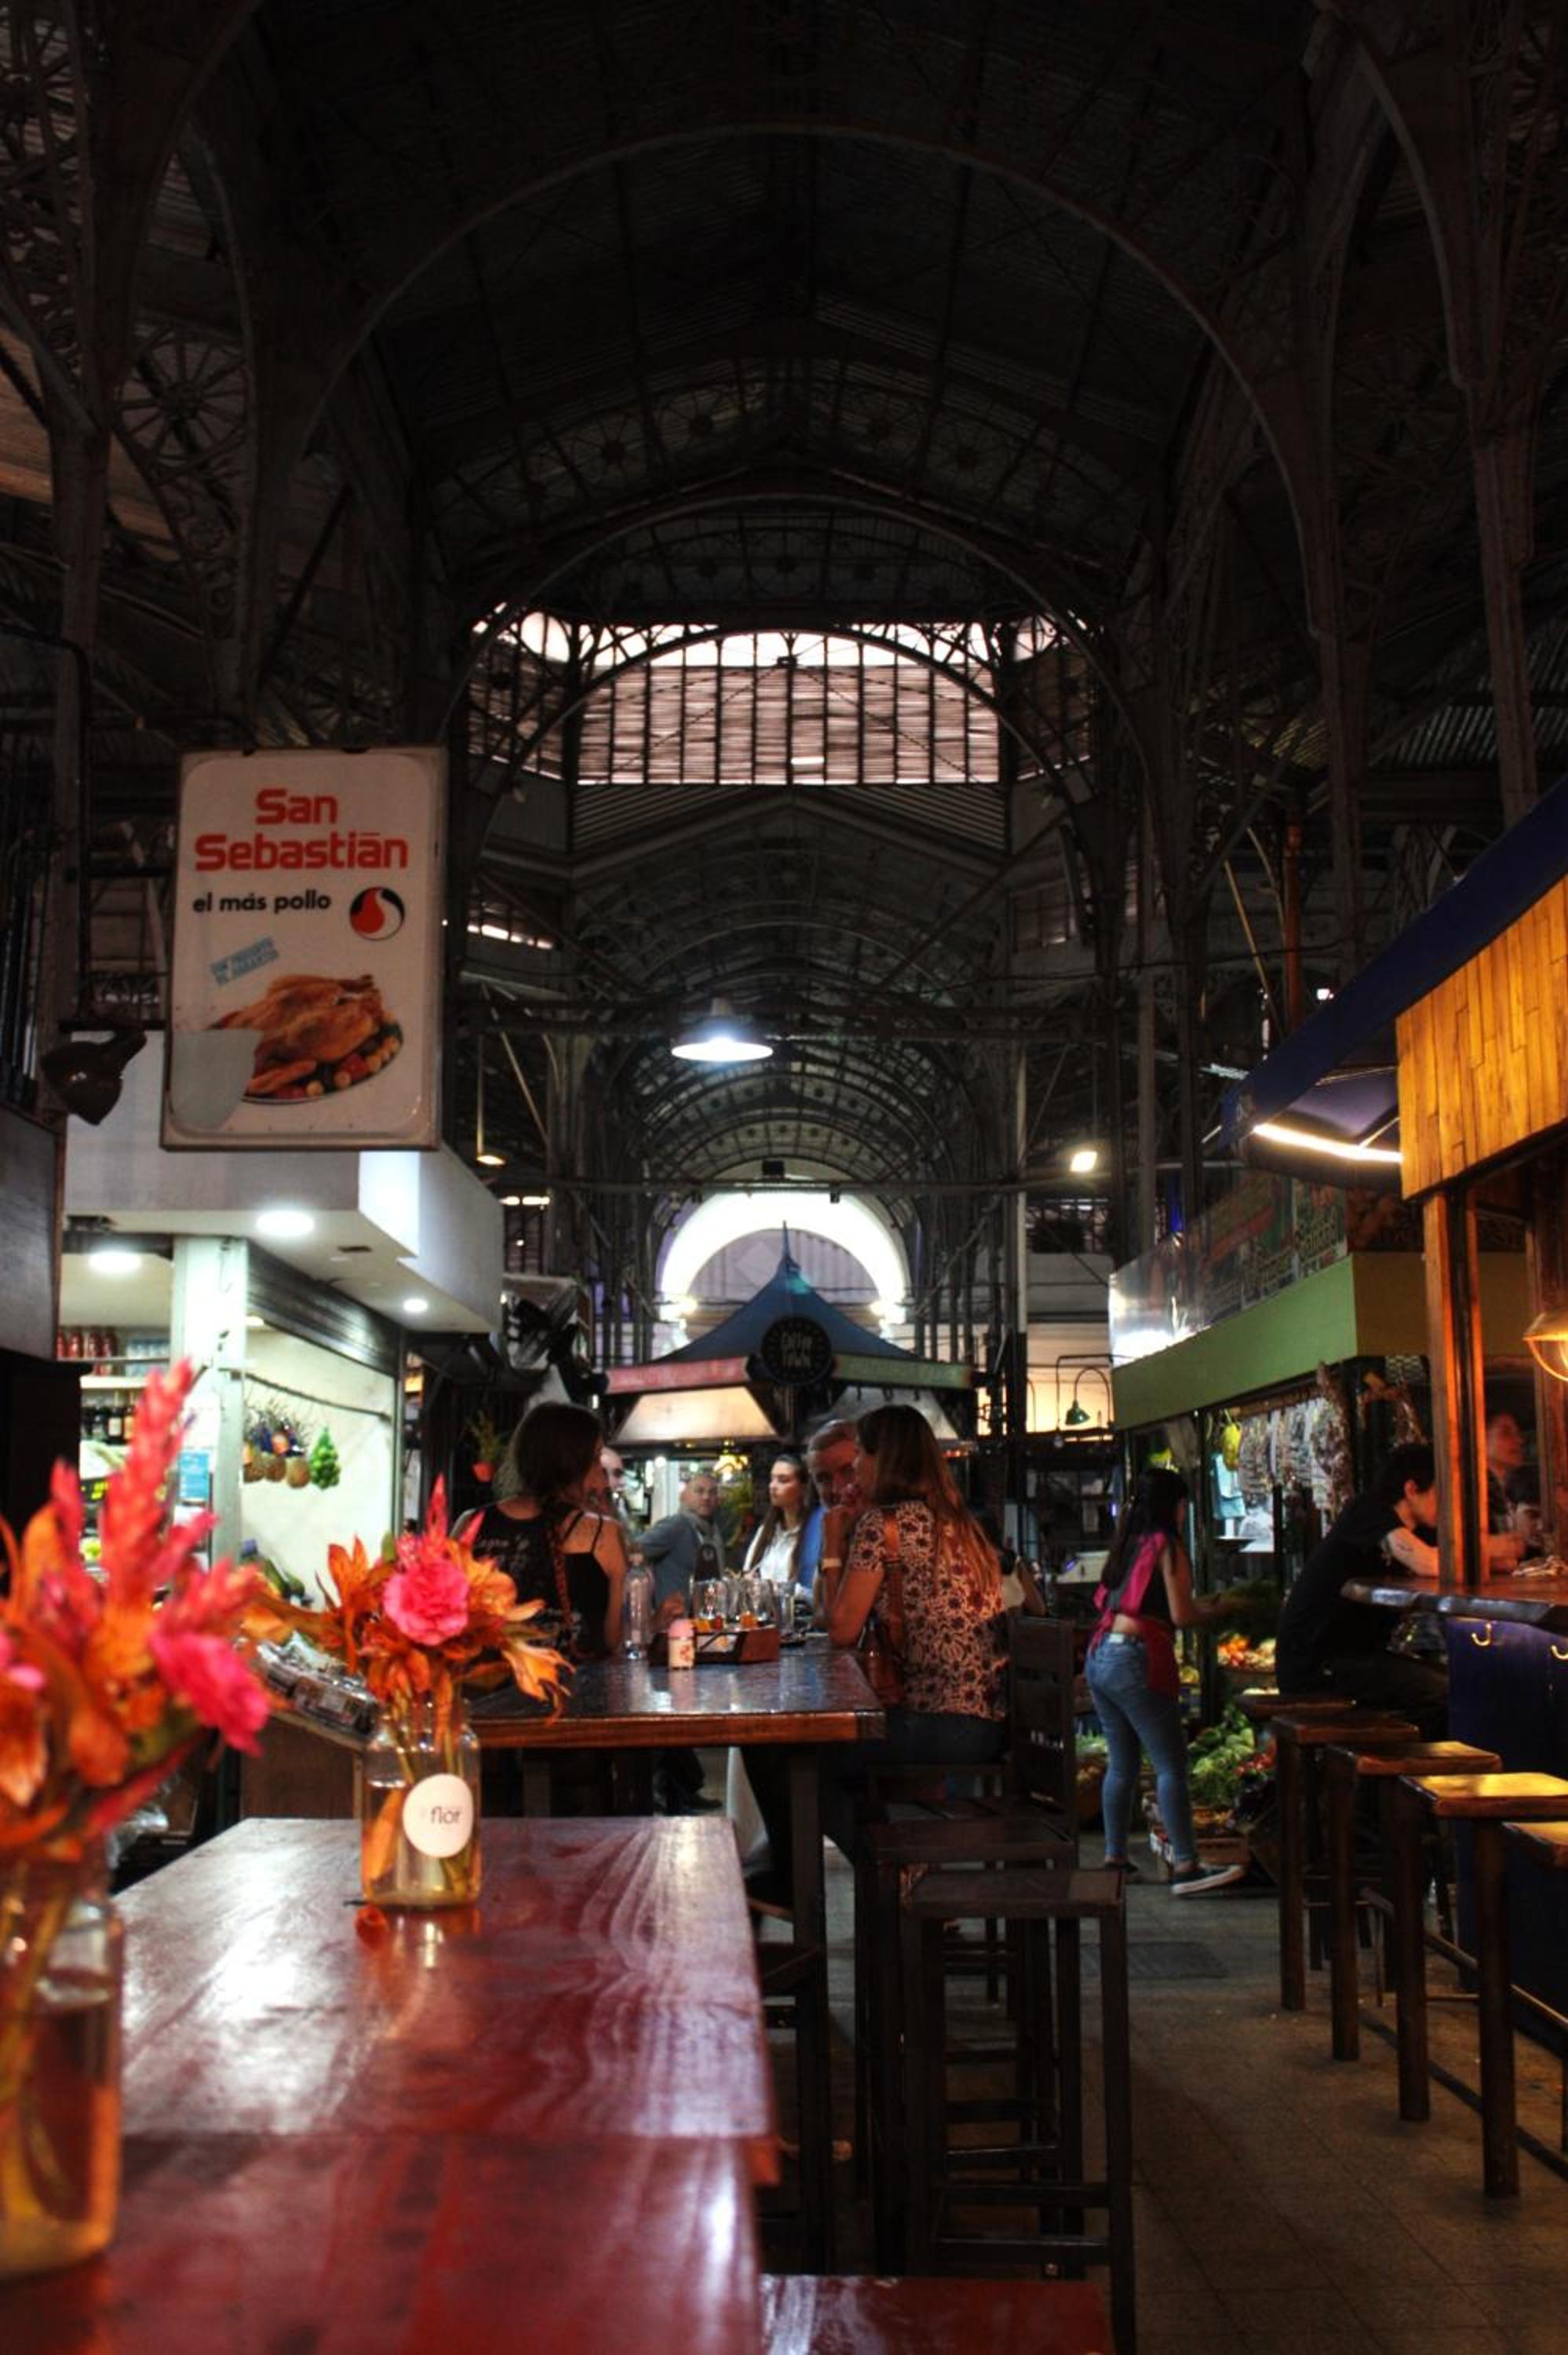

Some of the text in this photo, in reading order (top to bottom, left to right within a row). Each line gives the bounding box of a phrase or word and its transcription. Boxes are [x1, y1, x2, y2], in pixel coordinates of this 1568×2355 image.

[255, 787, 338, 825] San
[192, 889, 332, 915] el más pollo
[431, 1806, 461, 1824] flor
